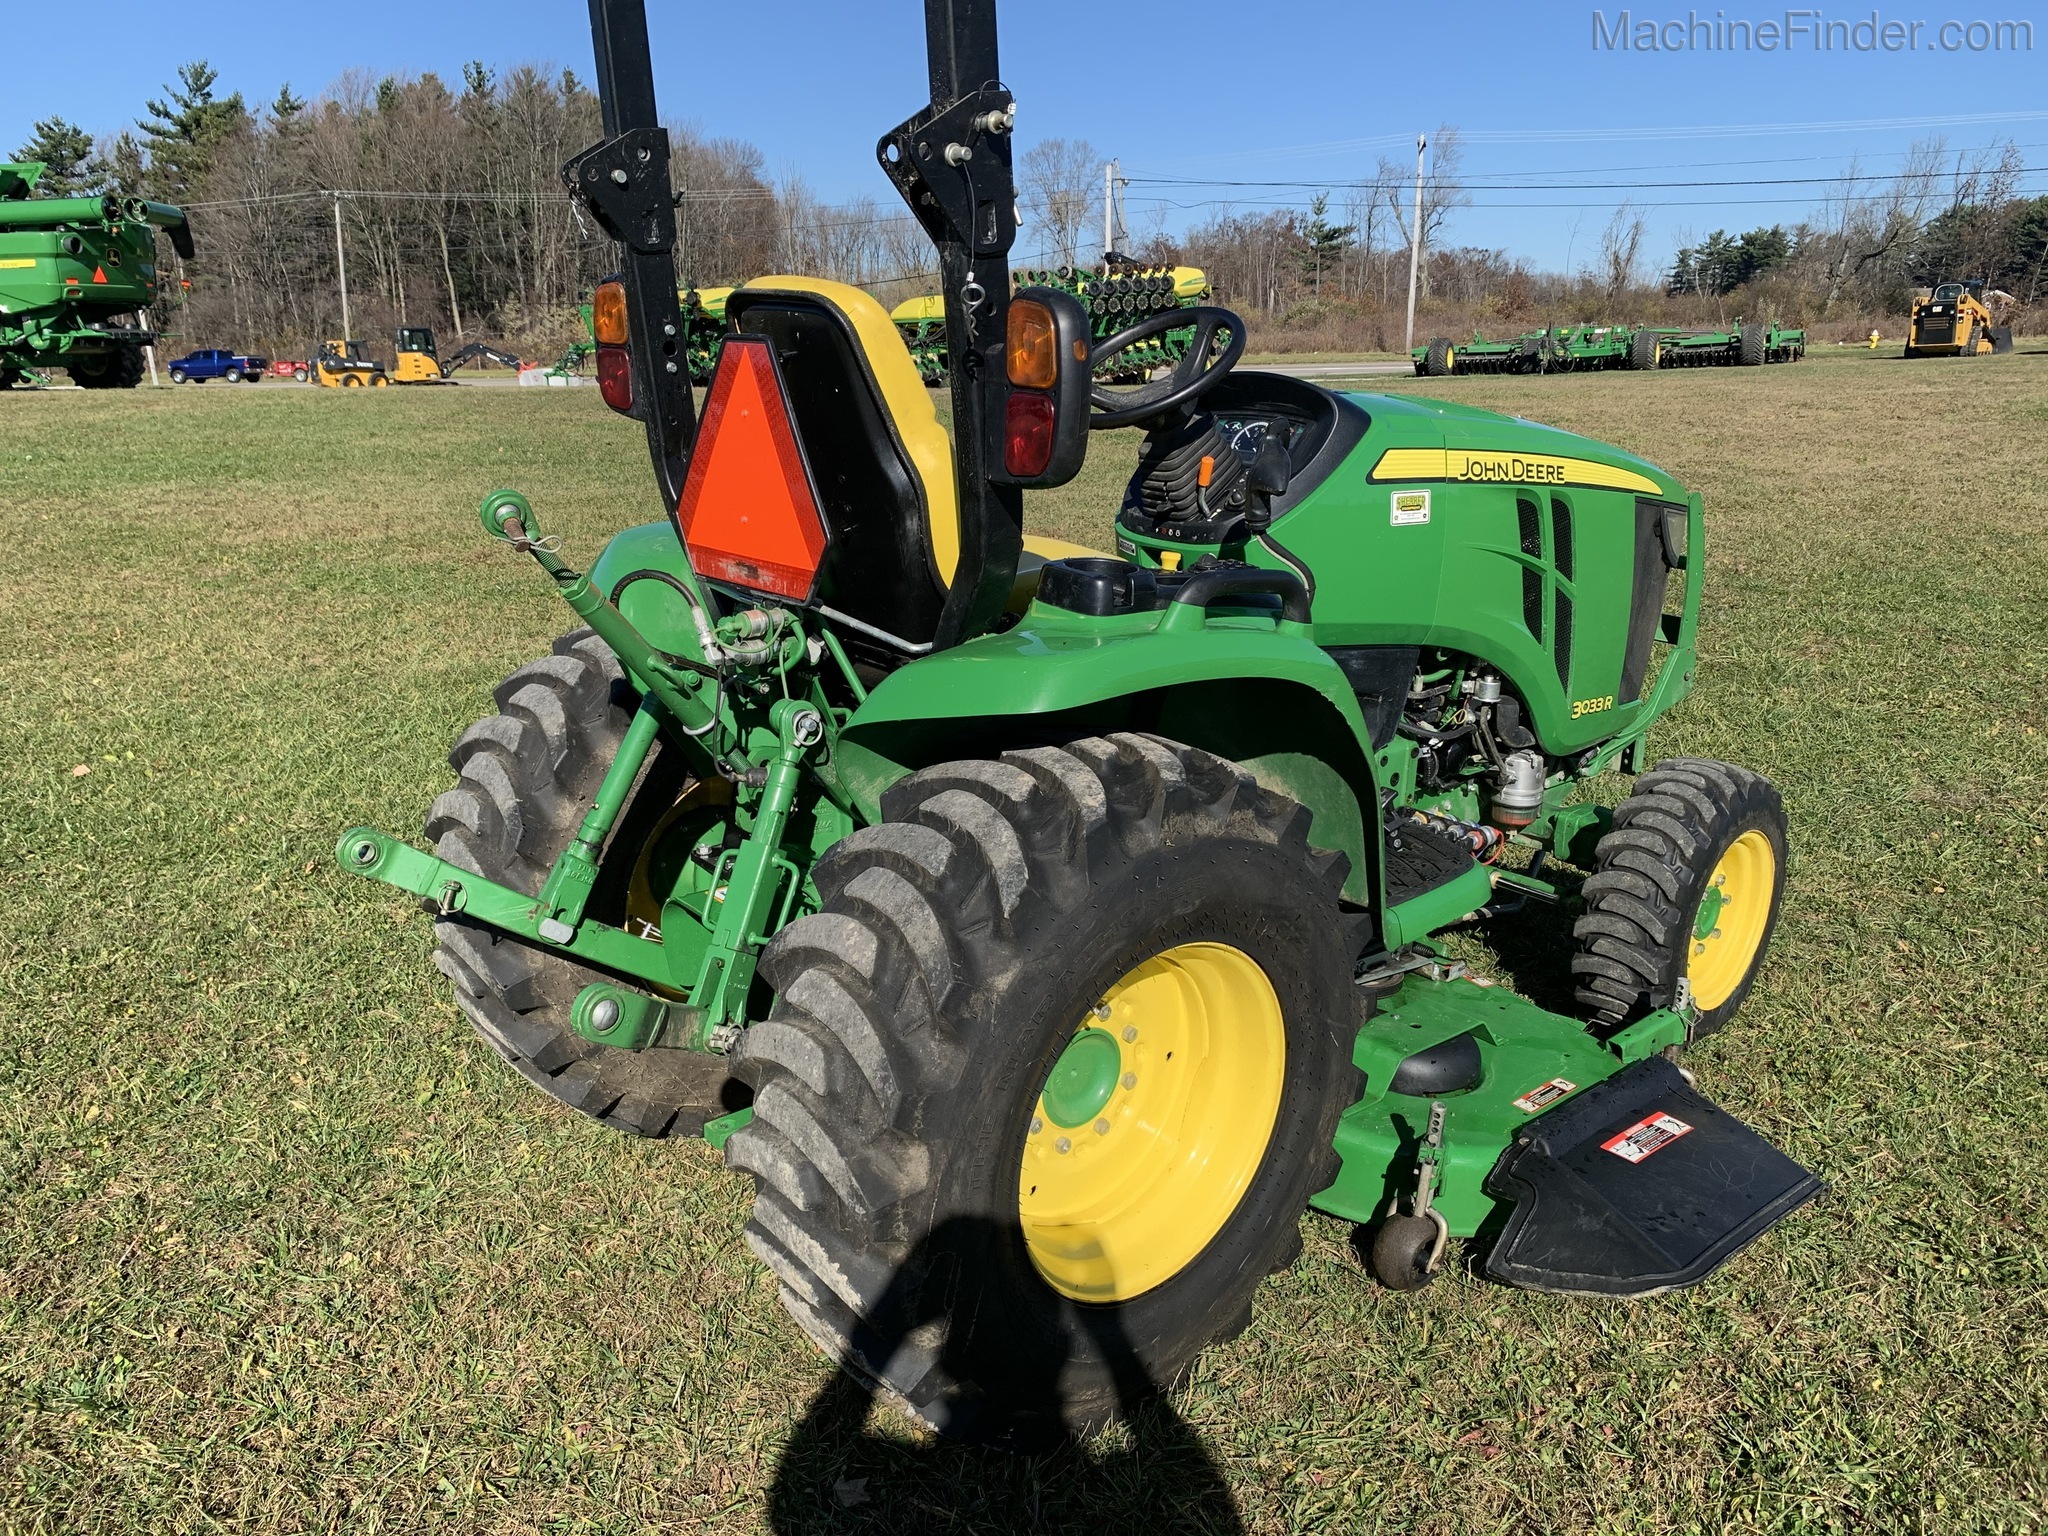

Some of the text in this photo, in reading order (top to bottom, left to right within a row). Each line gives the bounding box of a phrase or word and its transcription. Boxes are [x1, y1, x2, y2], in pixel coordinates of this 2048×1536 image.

[1460, 457, 1565, 481] JOHN DEERE
[1571, 695, 1613, 719] 3033R
